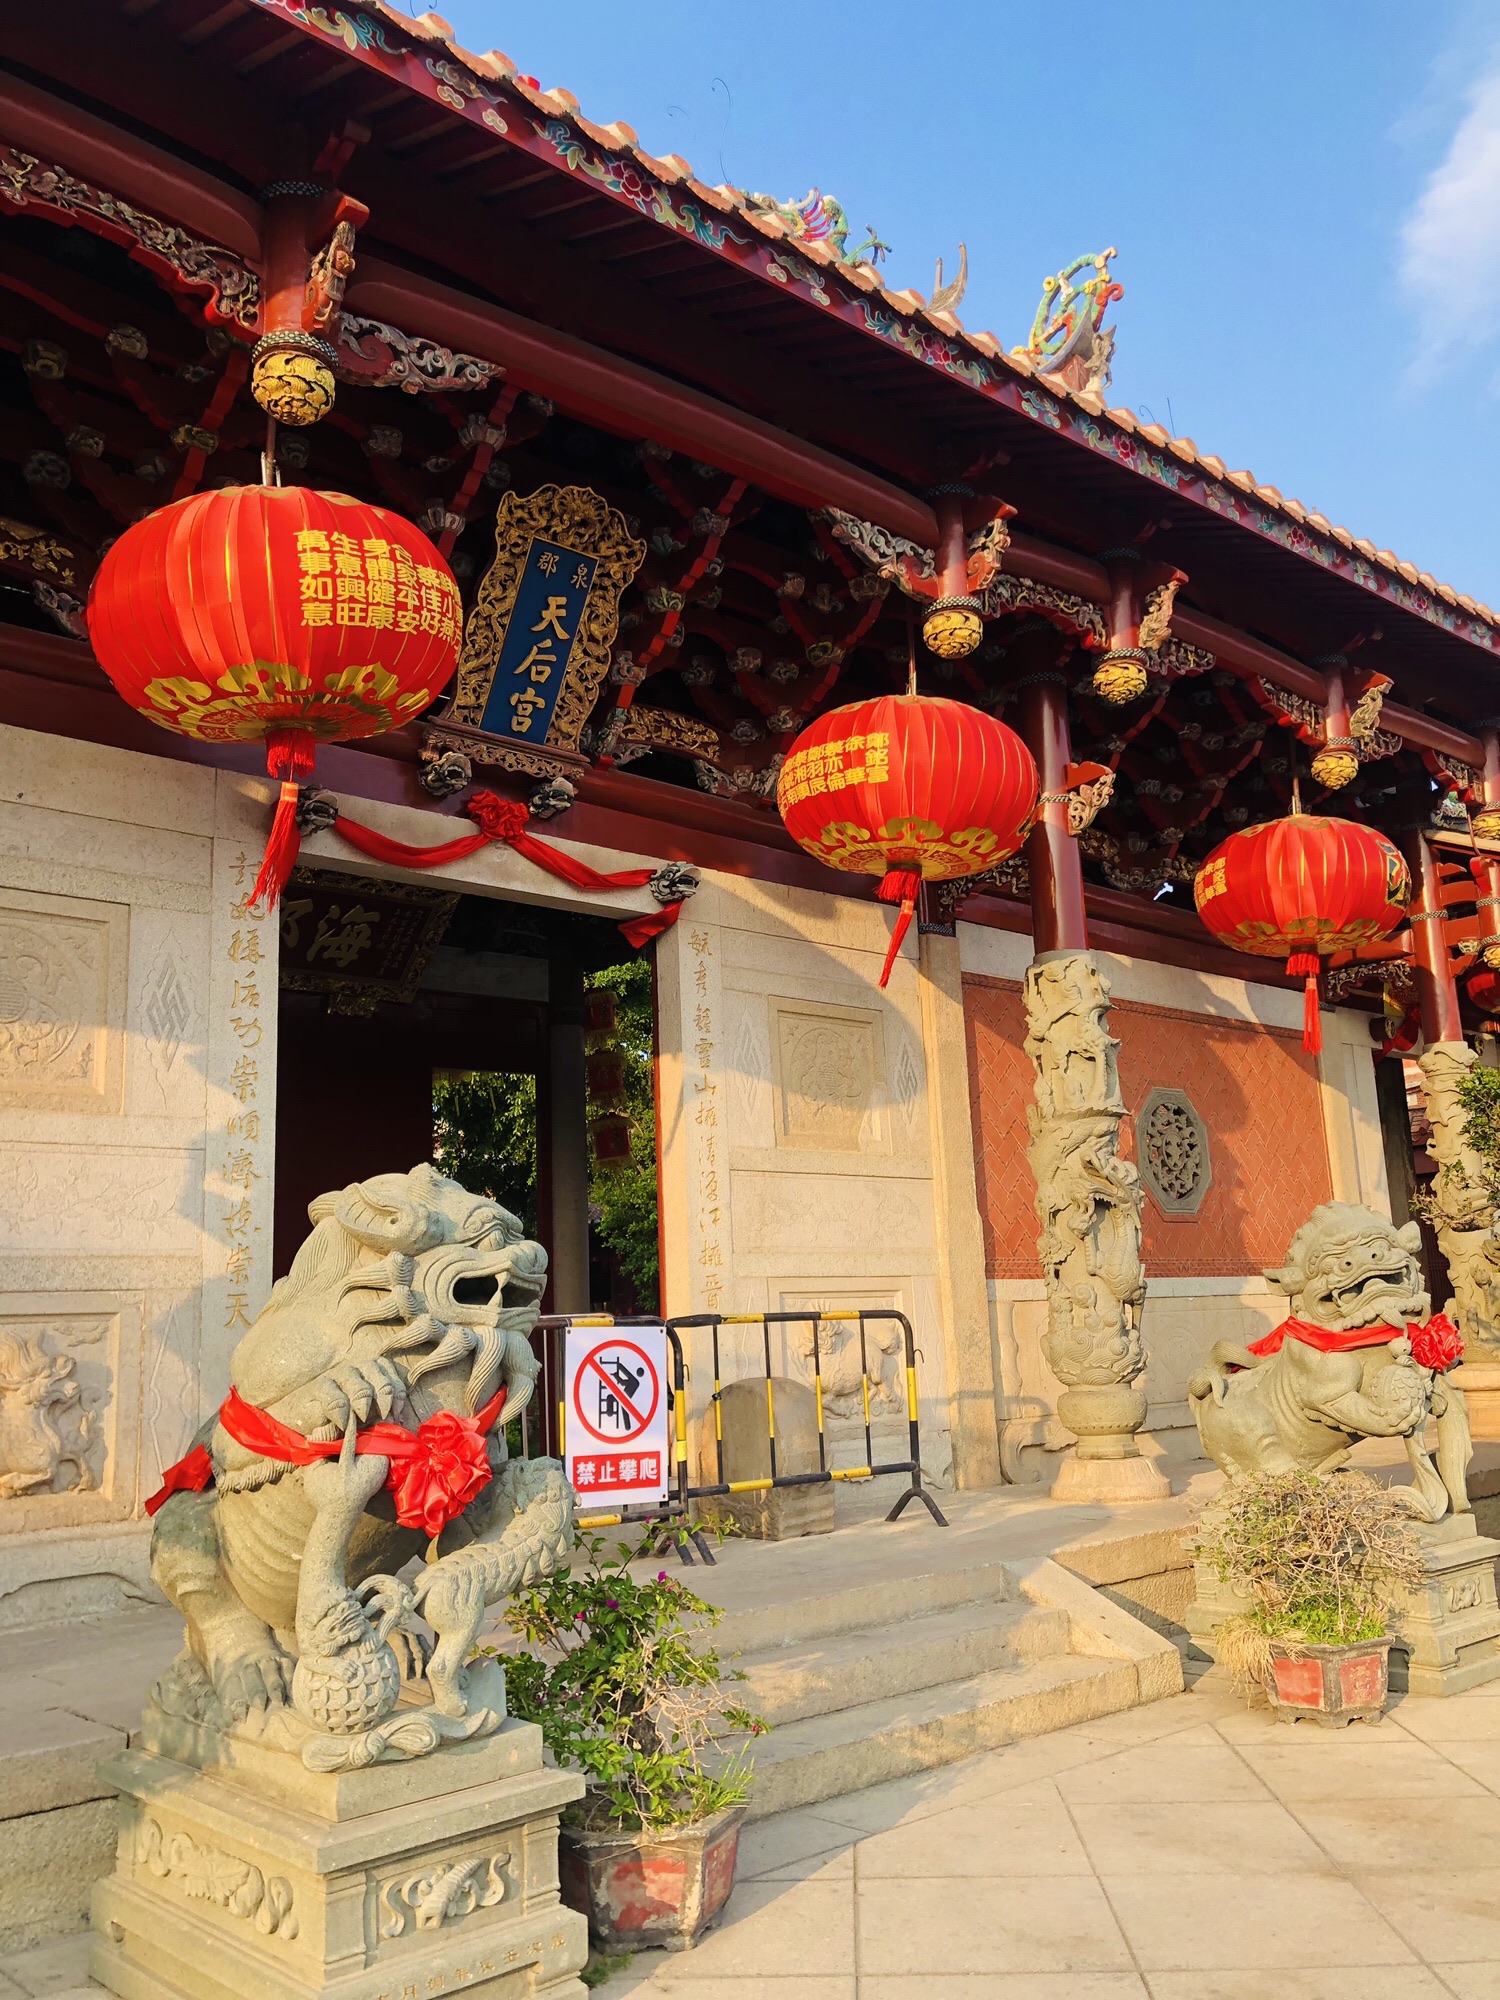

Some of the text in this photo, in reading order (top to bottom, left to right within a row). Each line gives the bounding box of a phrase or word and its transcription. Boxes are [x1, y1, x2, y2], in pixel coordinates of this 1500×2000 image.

[293, 529, 333, 627] 萬事如意
[330, 531, 367, 627] 生意興旺
[363, 539, 396, 630] 身體健康
[392, 544, 420, 635] 合家平安
[415, 564, 443, 635] 蔡佳好
[824, 740, 846, 793] 蔡亦倫
[865, 732, 889, 784] 鄭銘富
[576, 1457, 658, 1486] 禁止攀爬
